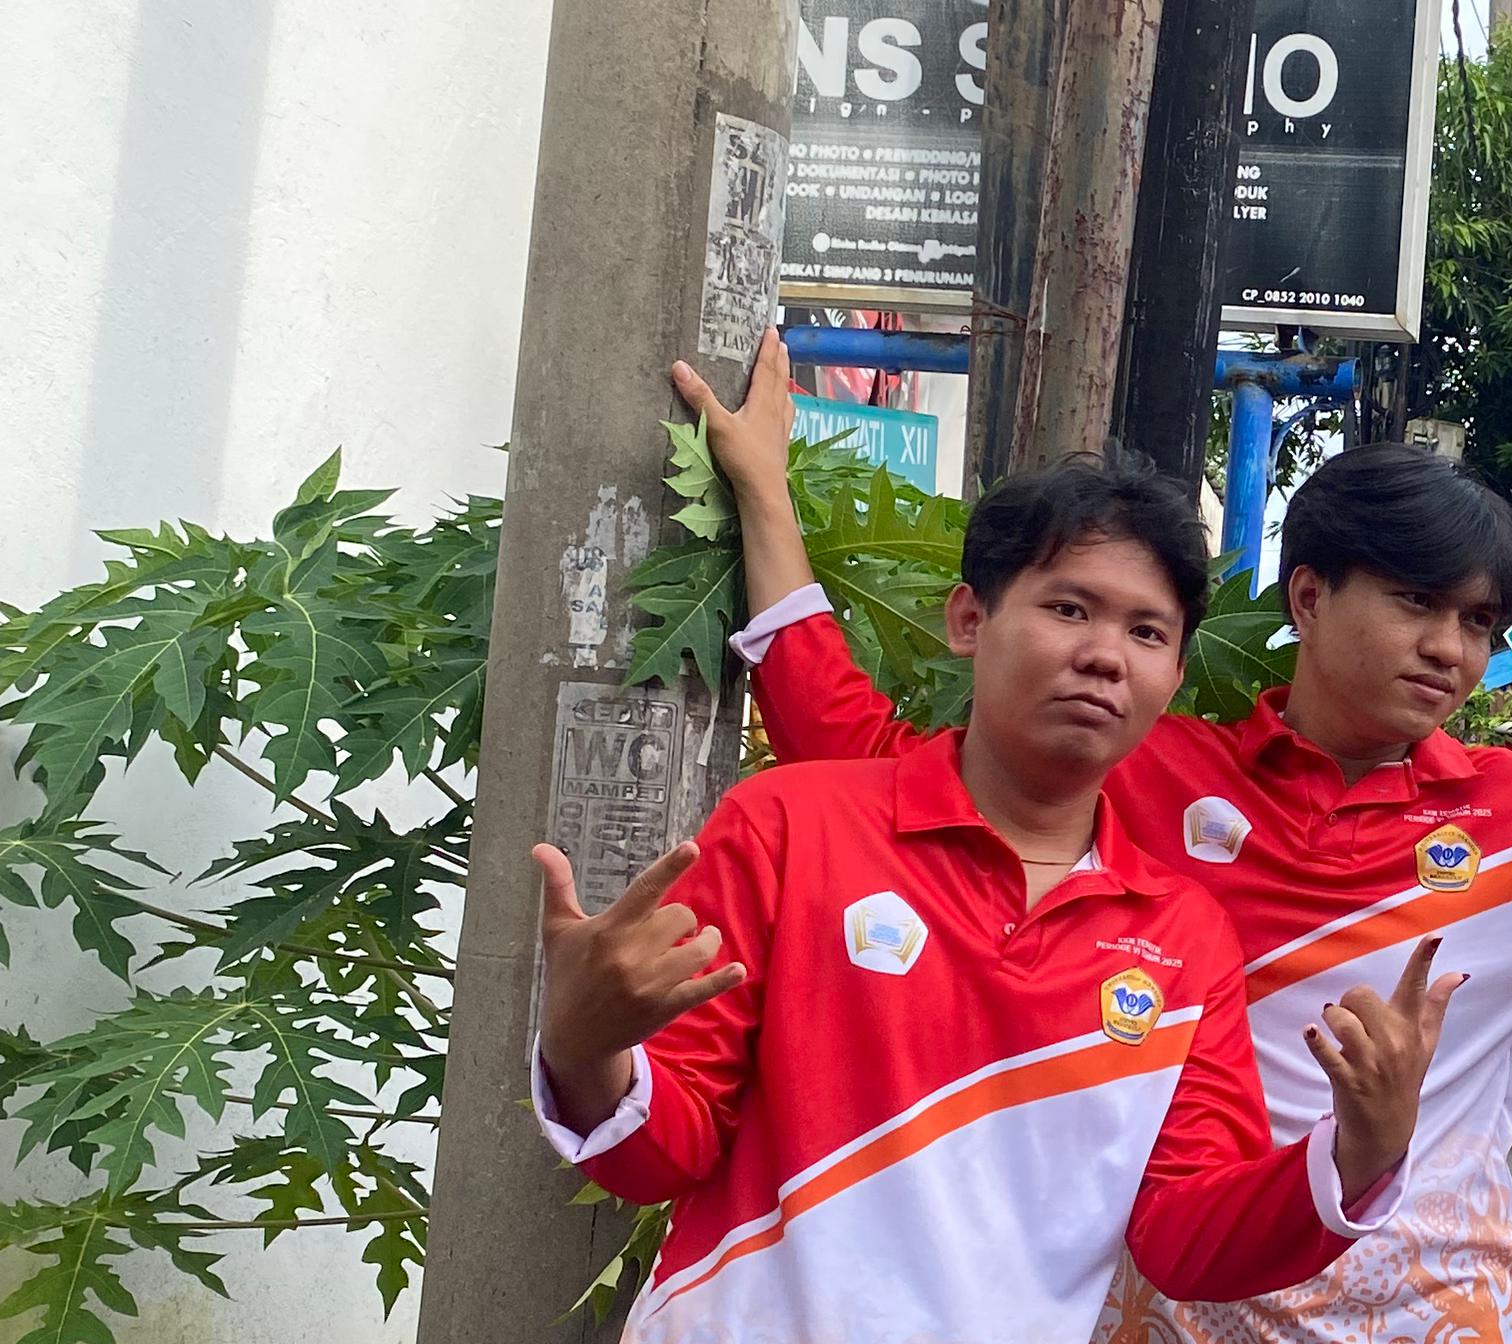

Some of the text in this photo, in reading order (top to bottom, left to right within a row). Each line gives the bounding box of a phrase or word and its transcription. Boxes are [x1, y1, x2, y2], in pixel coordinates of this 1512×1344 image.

[809, 144, 860, 160] PHOTO
[797, 163, 899, 182] DOKUMENTASI
[919, 169, 970, 185] PHOTO
[839, 185, 926, 203] UNDANGAN
[865, 205, 918, 221] DESAIN
[883, 268, 893, 281] 3
[1298, 291, 1331, 305] 2010
[1334, 294, 1365, 307] 1040
[900, 425, 928, 465] XII
[566, 727, 666, 782] WC
